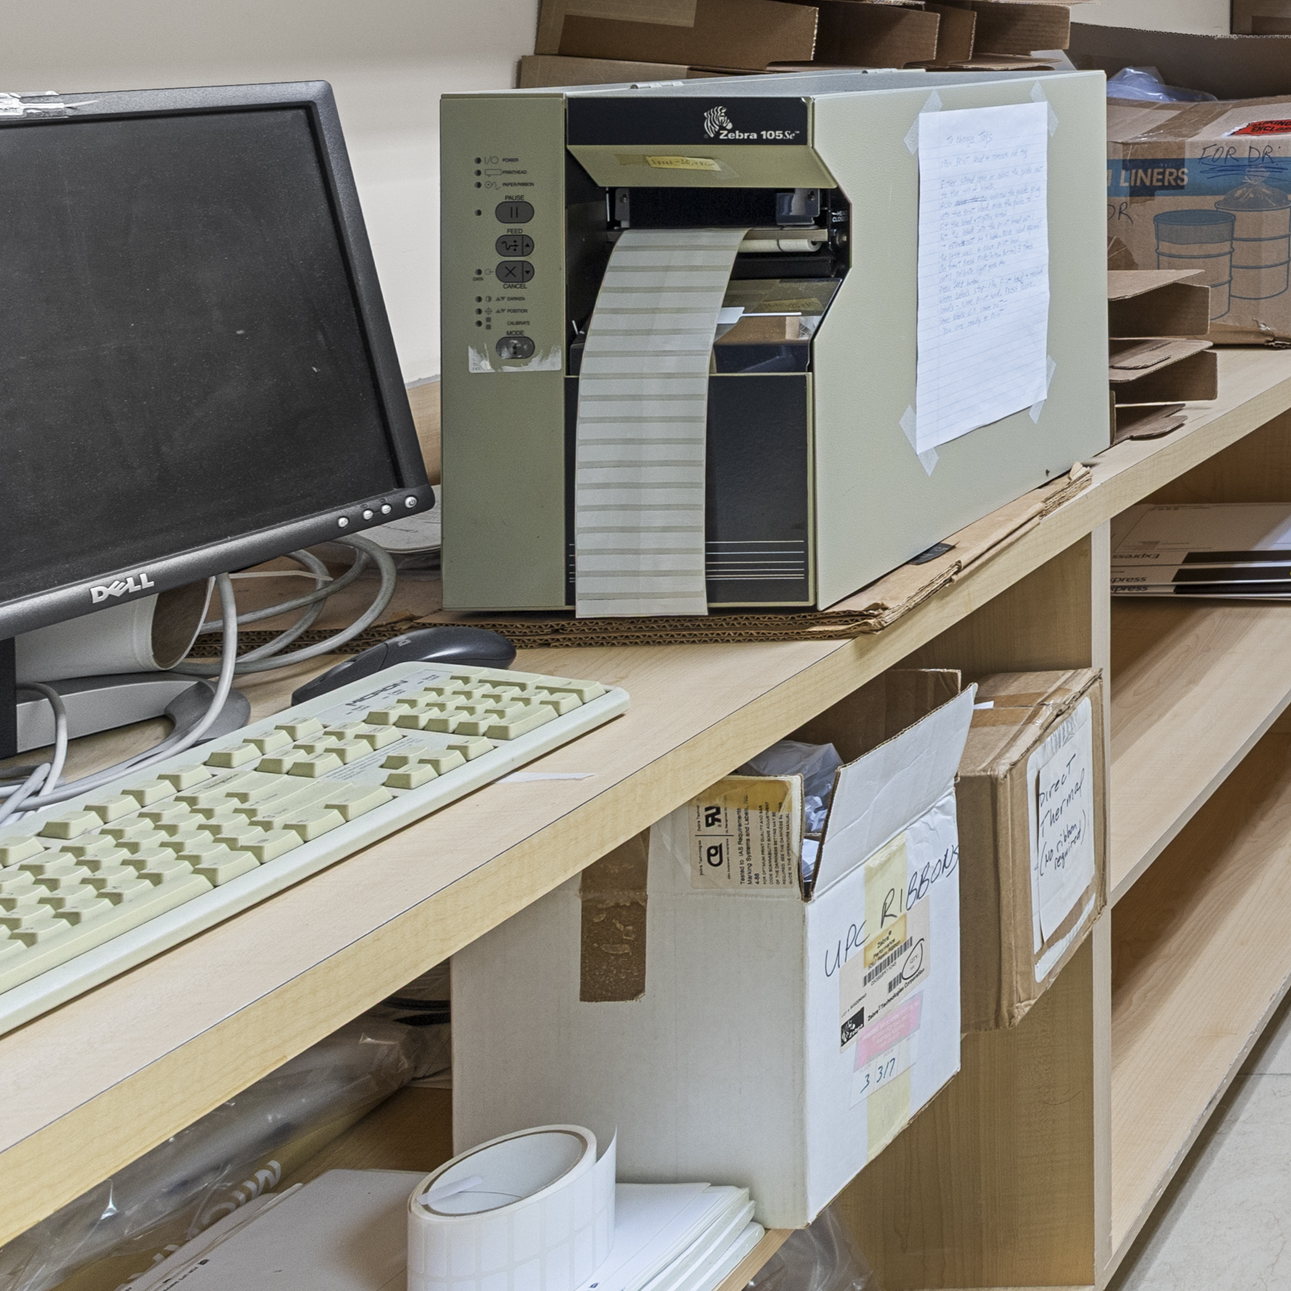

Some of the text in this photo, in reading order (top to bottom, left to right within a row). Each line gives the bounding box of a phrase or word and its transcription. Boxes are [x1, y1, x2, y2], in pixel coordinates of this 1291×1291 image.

[719, 130, 757, 140] Zebra
[1198, 143, 1240, 166] FOR
[1119, 168, 1189, 188] LINERS
[90, 573, 154, 604] DELL
[345, 679, 408, 706] MICRON
[825, 843, 960, 977] UPC RIBBONS
